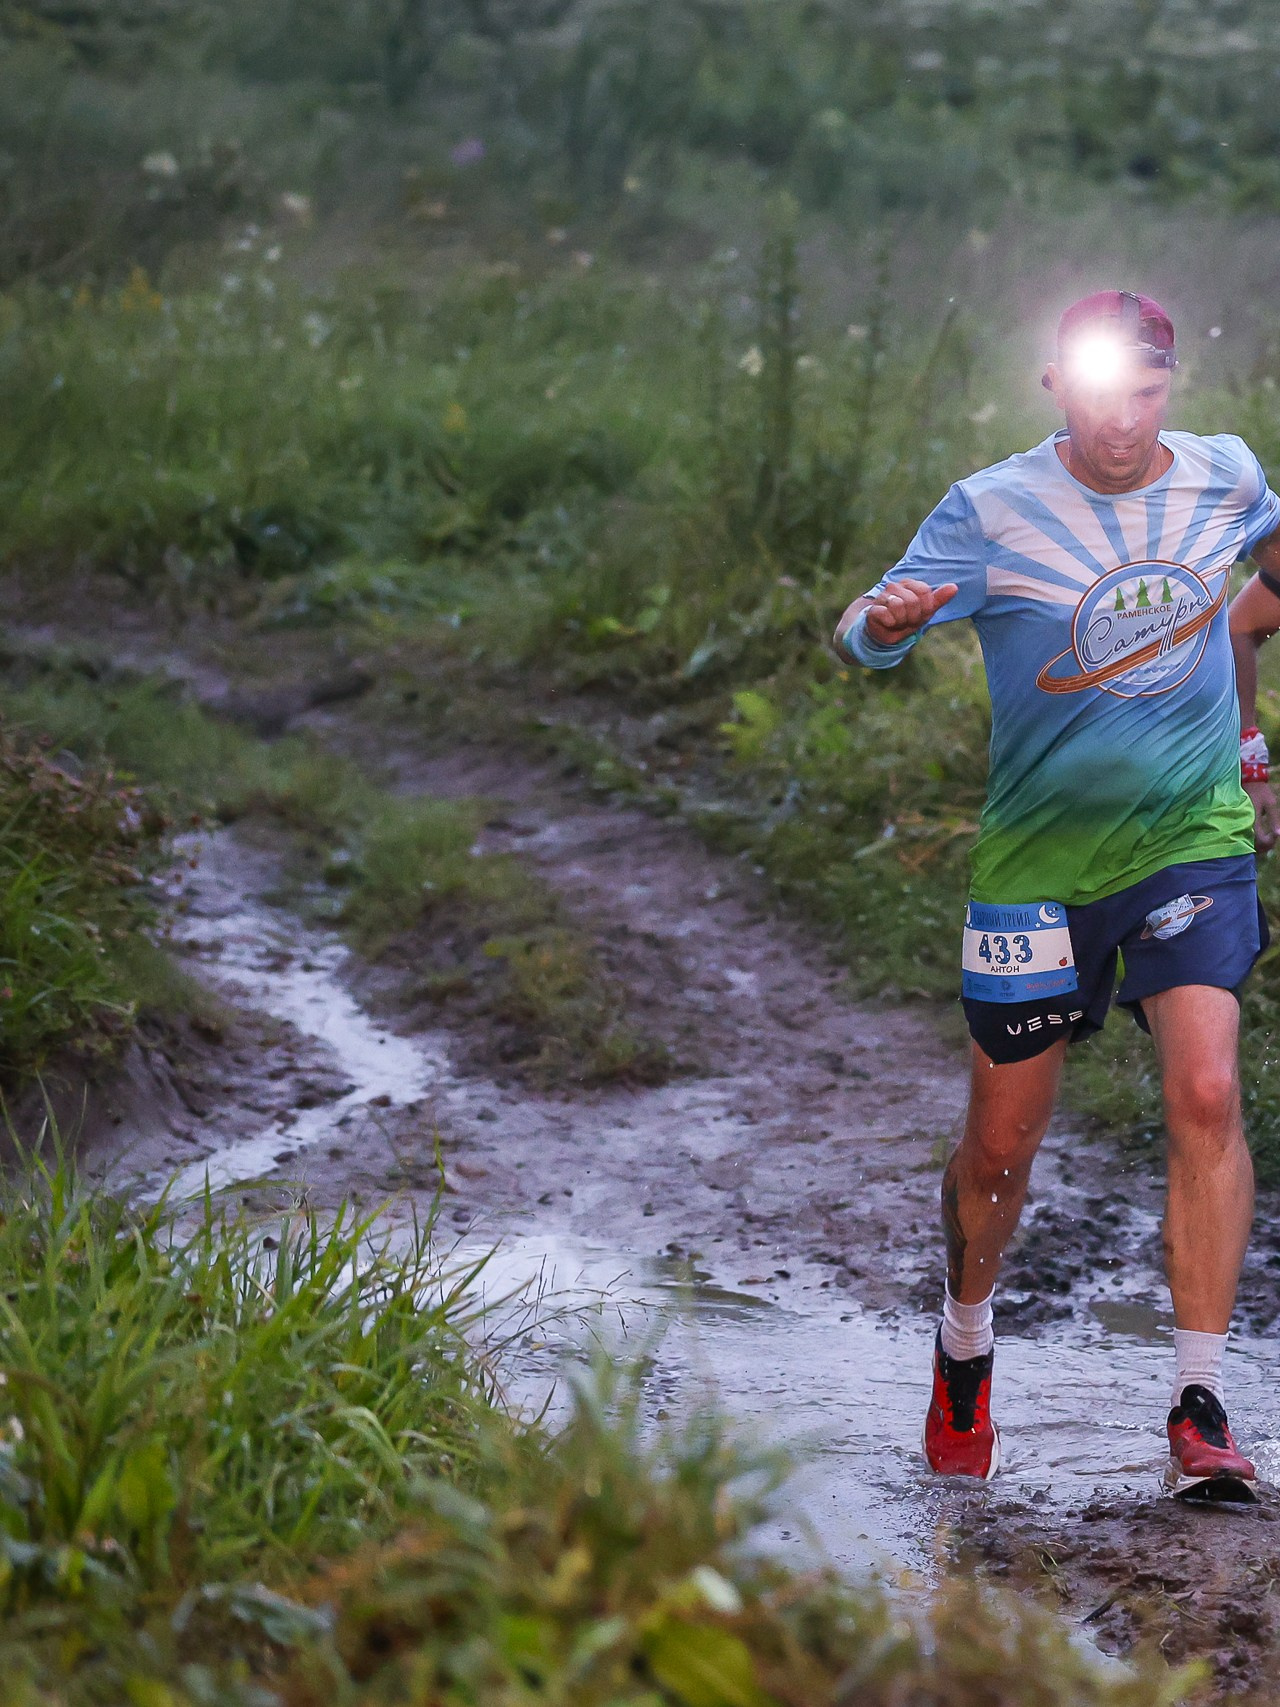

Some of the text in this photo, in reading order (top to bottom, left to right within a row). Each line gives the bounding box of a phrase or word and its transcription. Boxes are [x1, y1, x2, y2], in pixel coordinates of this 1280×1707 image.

[1117, 604, 1172, 620] РАМЕНСКОЕ
[978, 934, 1033, 965] 433
[990, 965, 1020, 974] АНТОН
